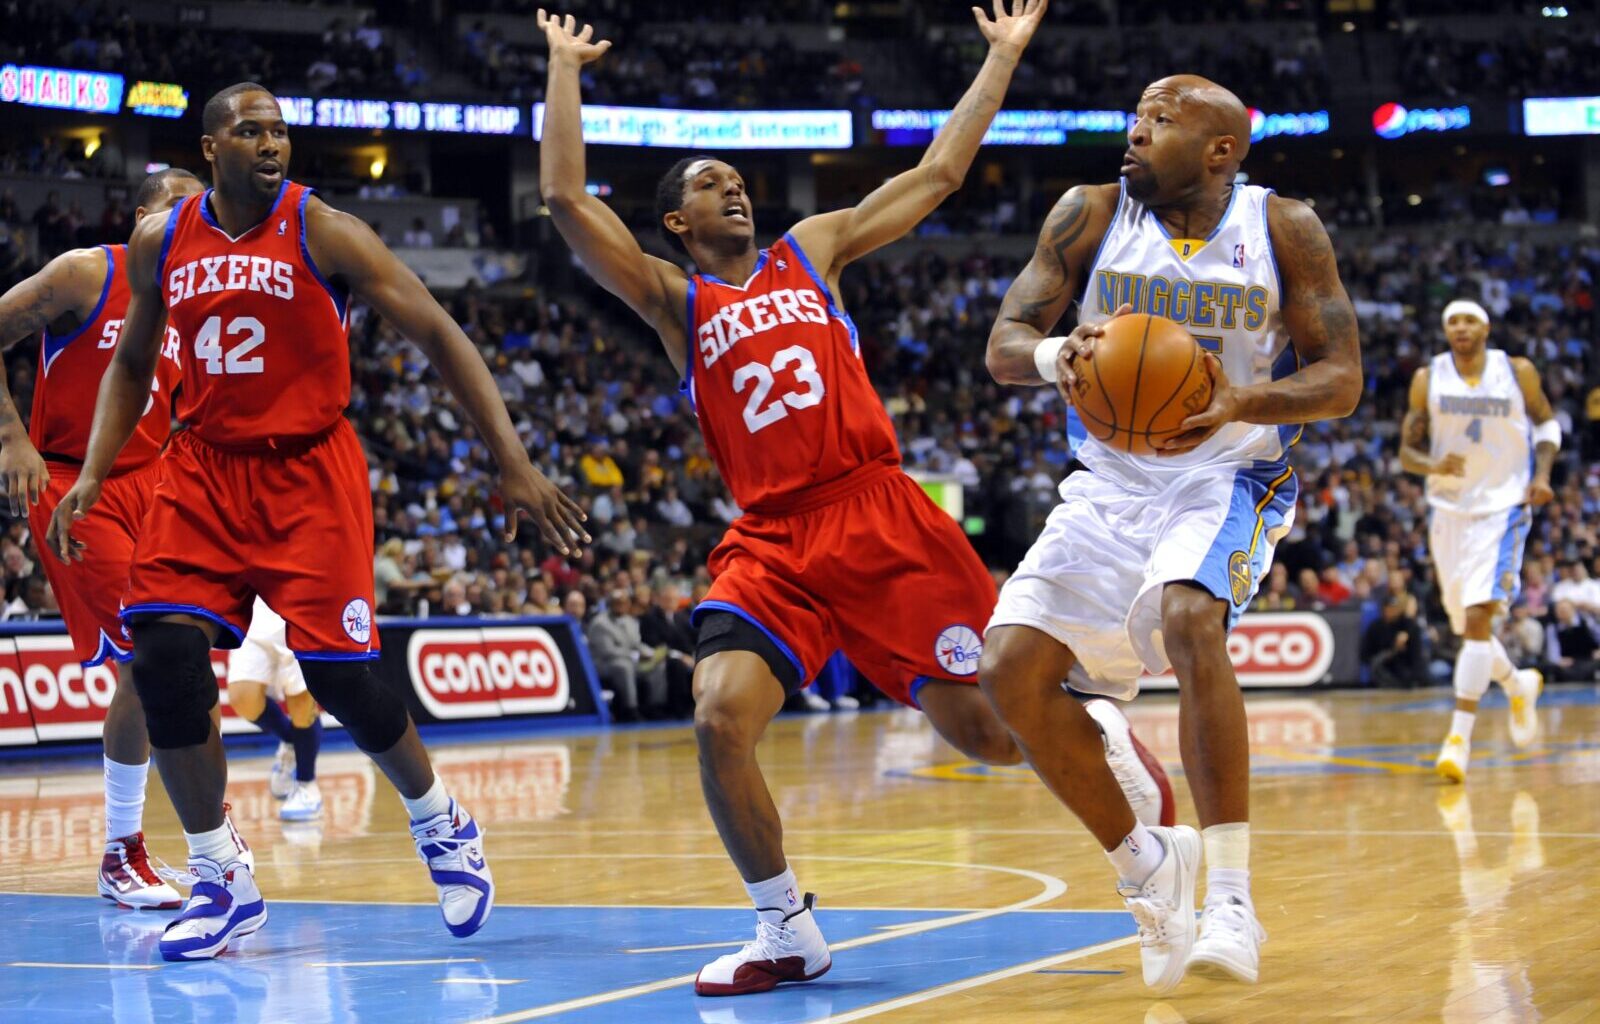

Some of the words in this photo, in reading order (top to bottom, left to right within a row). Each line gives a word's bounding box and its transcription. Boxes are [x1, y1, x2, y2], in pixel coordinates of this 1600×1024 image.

[2, 67, 109, 108] SHARKS
[391, 101, 421, 129] TO
[422, 102, 463, 132] THE
[464, 105, 520, 134] HOOP
[618, 114, 666, 144] High
[674, 115, 742, 145] Speed
[1183, 243, 1190, 256] D
[169, 255, 294, 307] SIXERS
[1097, 270, 1268, 331] NUGGETS
[194, 316, 265, 374] 42
[697, 288, 829, 369] SIXERS
[732, 344, 825, 434] 23
[1465, 418, 1482, 442] 4
[1226, 631, 1314, 668] oco
[0, 663, 118, 714] noco
